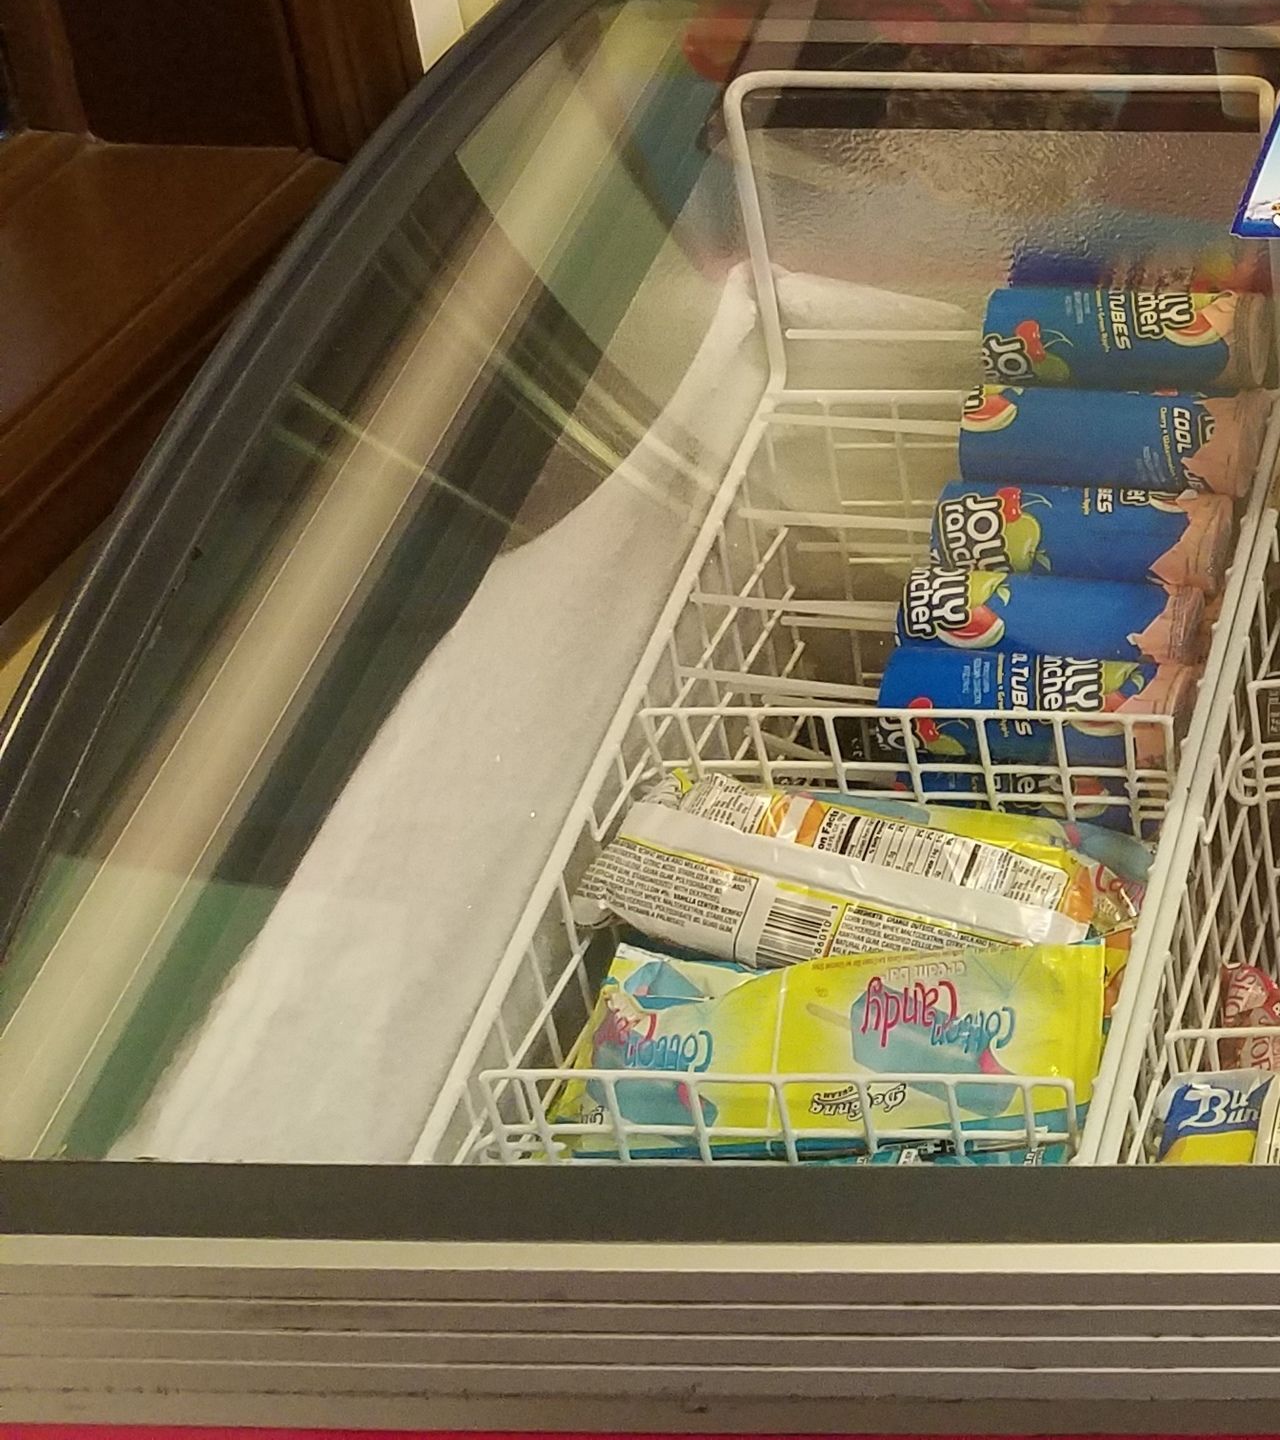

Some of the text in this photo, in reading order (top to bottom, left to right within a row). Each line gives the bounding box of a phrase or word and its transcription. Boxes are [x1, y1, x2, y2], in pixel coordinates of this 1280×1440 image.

[1173, 407, 1193, 453] COOL
[861, 975, 958, 1049] Candy
[930, 1006, 1018, 1056] Cotton
